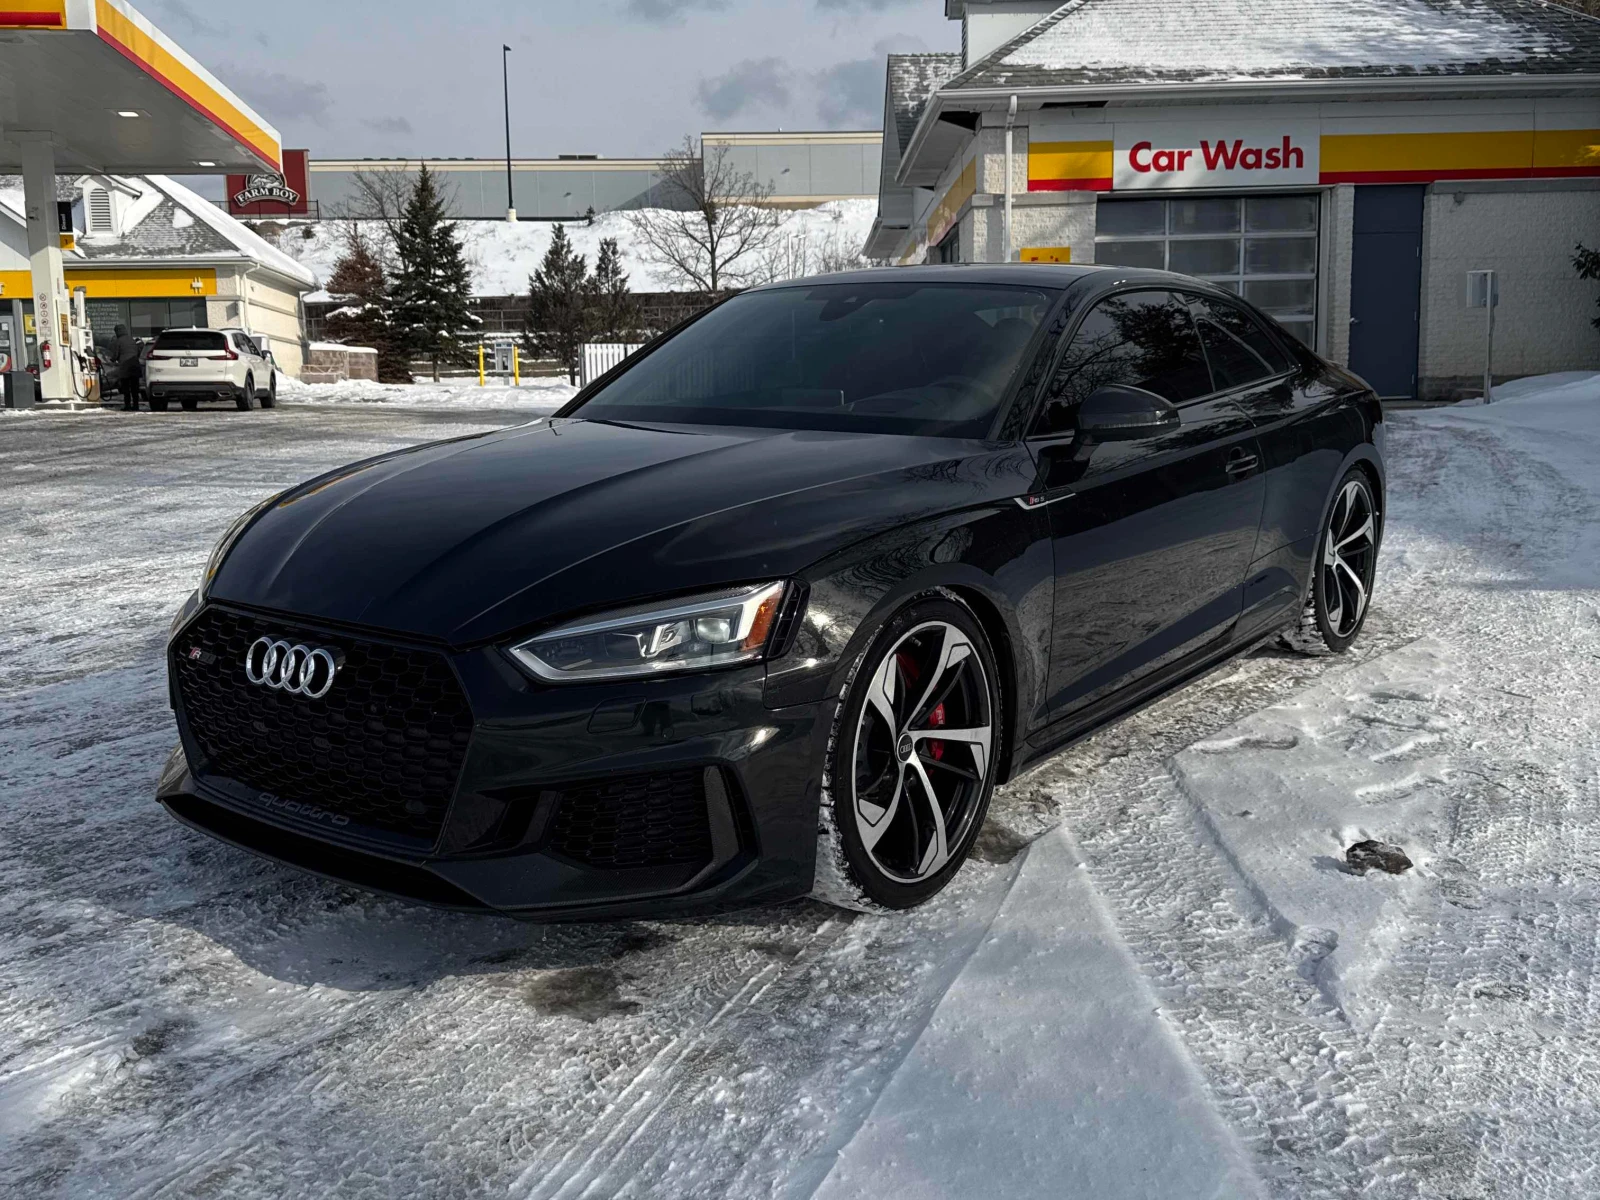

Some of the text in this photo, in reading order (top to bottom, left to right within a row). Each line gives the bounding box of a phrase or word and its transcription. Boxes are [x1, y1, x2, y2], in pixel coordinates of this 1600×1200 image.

[1129, 136, 1304, 173] Car Wash
[238, 187, 297, 202] FARM BOY
[259, 792, 350, 826] quattro
